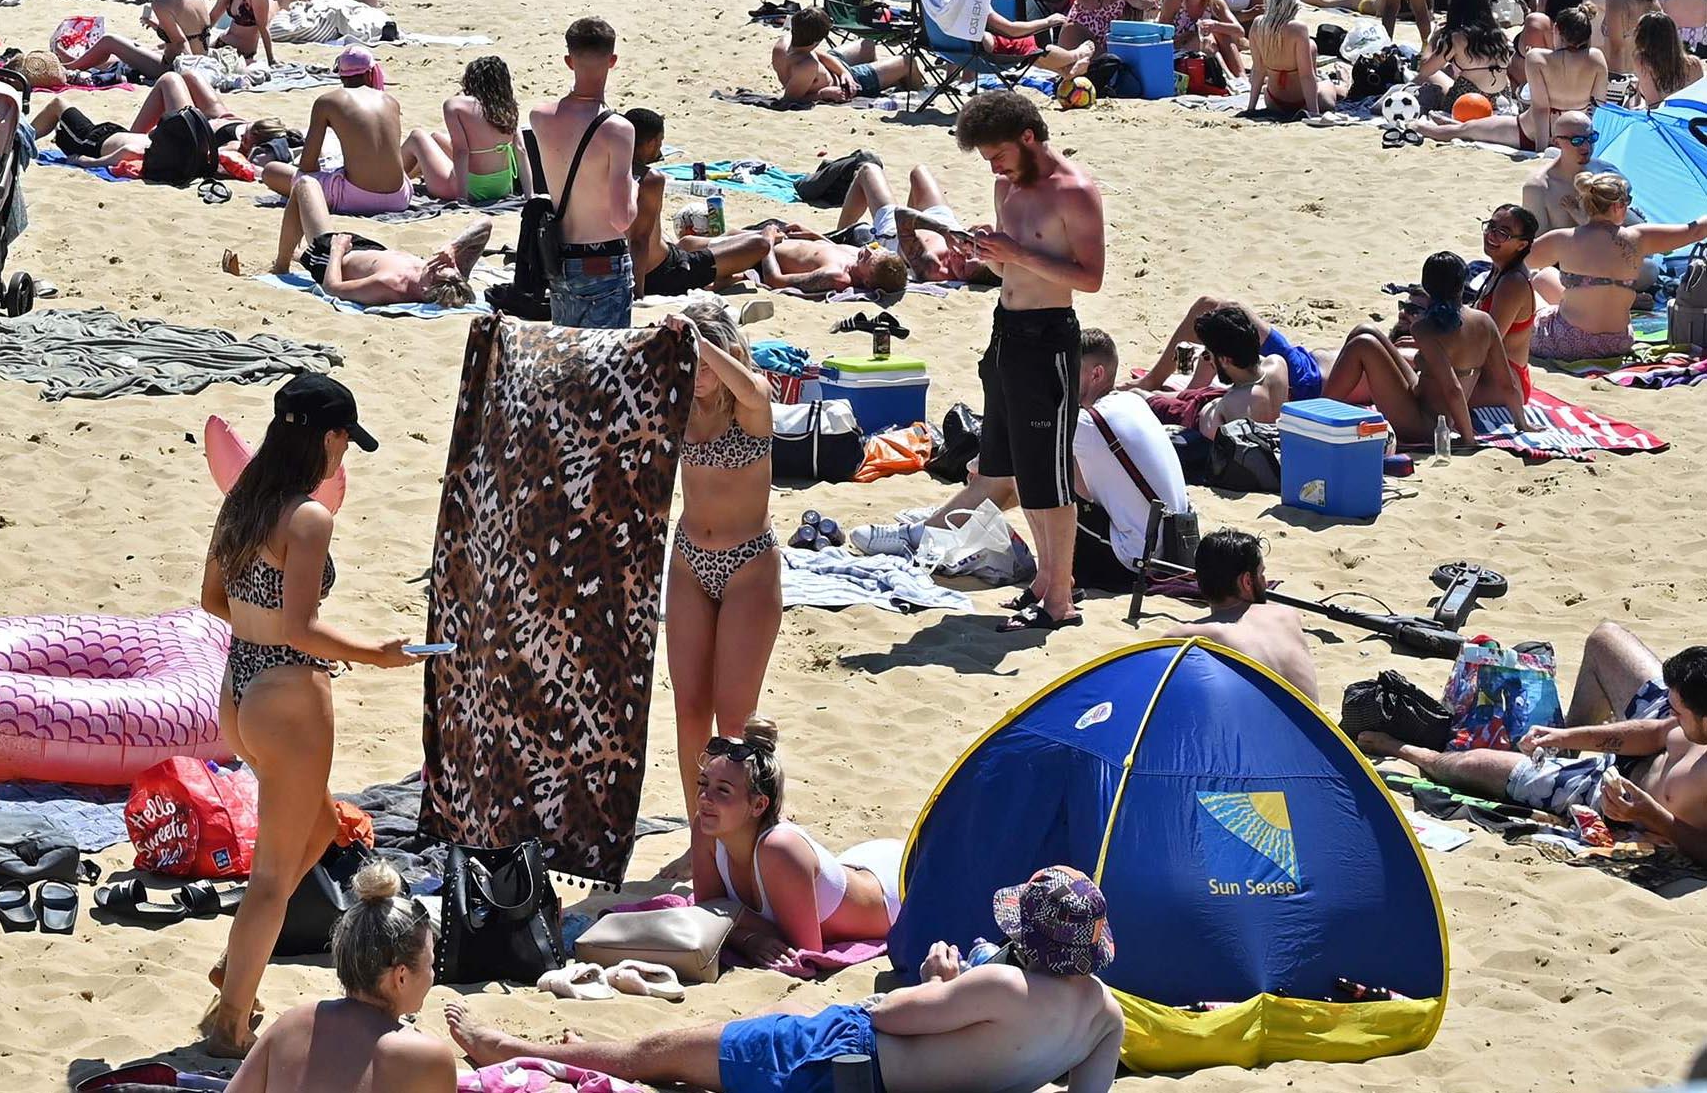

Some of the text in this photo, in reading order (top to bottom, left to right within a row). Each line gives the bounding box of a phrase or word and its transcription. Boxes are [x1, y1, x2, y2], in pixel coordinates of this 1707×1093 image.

[129, 795, 176, 829] Hello
[135, 818, 188, 859] Sweetie
[1209, 879, 1295, 895] Sun Sense
